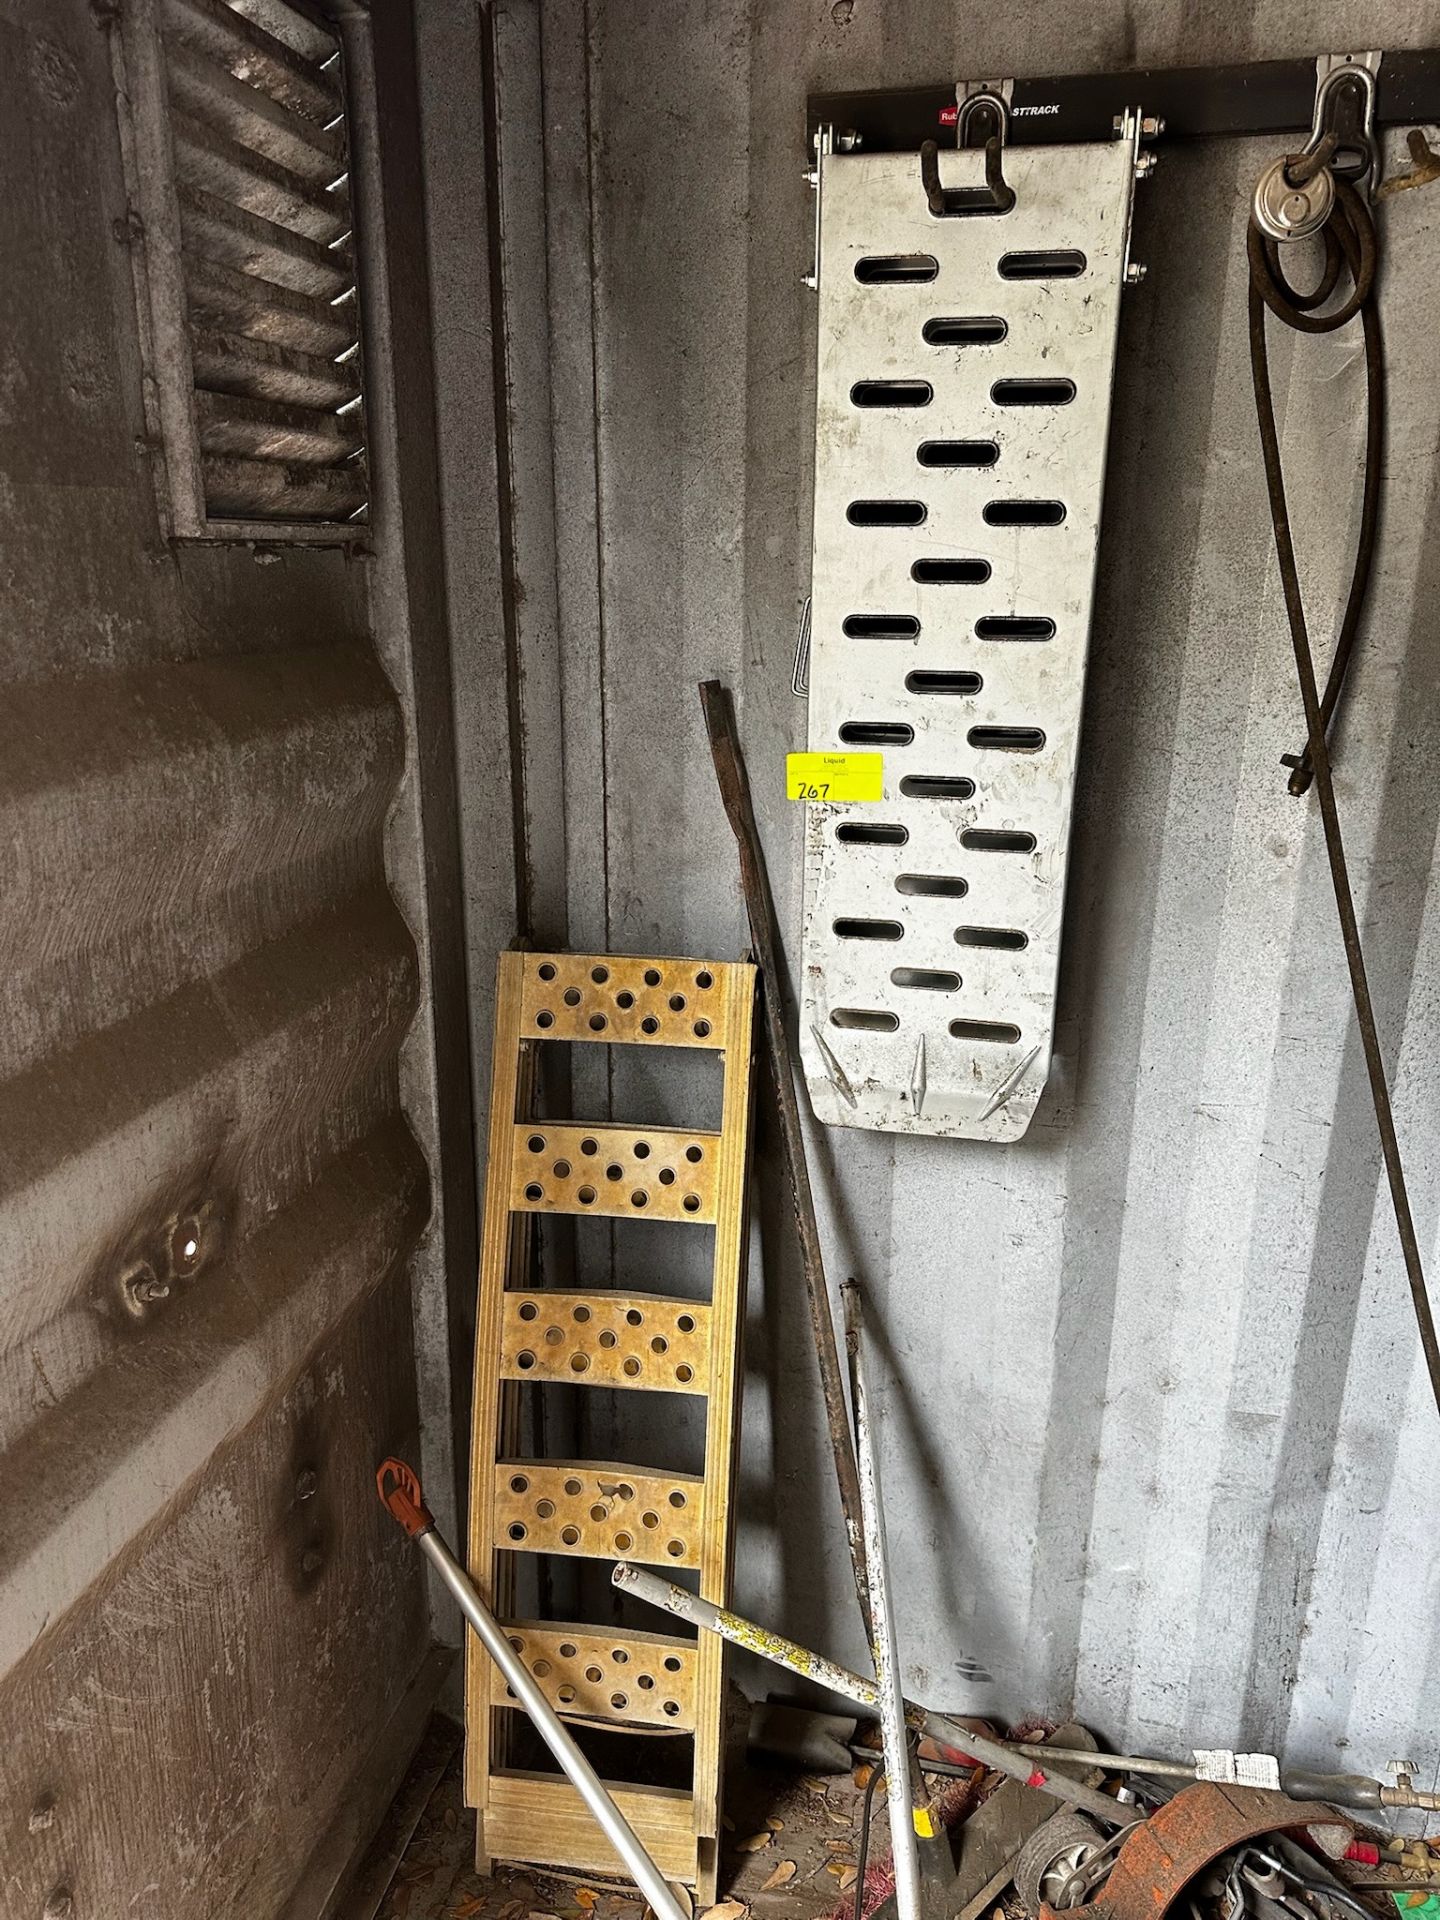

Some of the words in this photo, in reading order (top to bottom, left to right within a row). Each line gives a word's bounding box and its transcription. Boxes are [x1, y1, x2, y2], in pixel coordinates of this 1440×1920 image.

[1012, 105, 1060, 116] STTRACK
[941, 112, 958, 121] Rub
[823, 757, 846, 765] Liquid
[798, 782, 830, 800] 267
